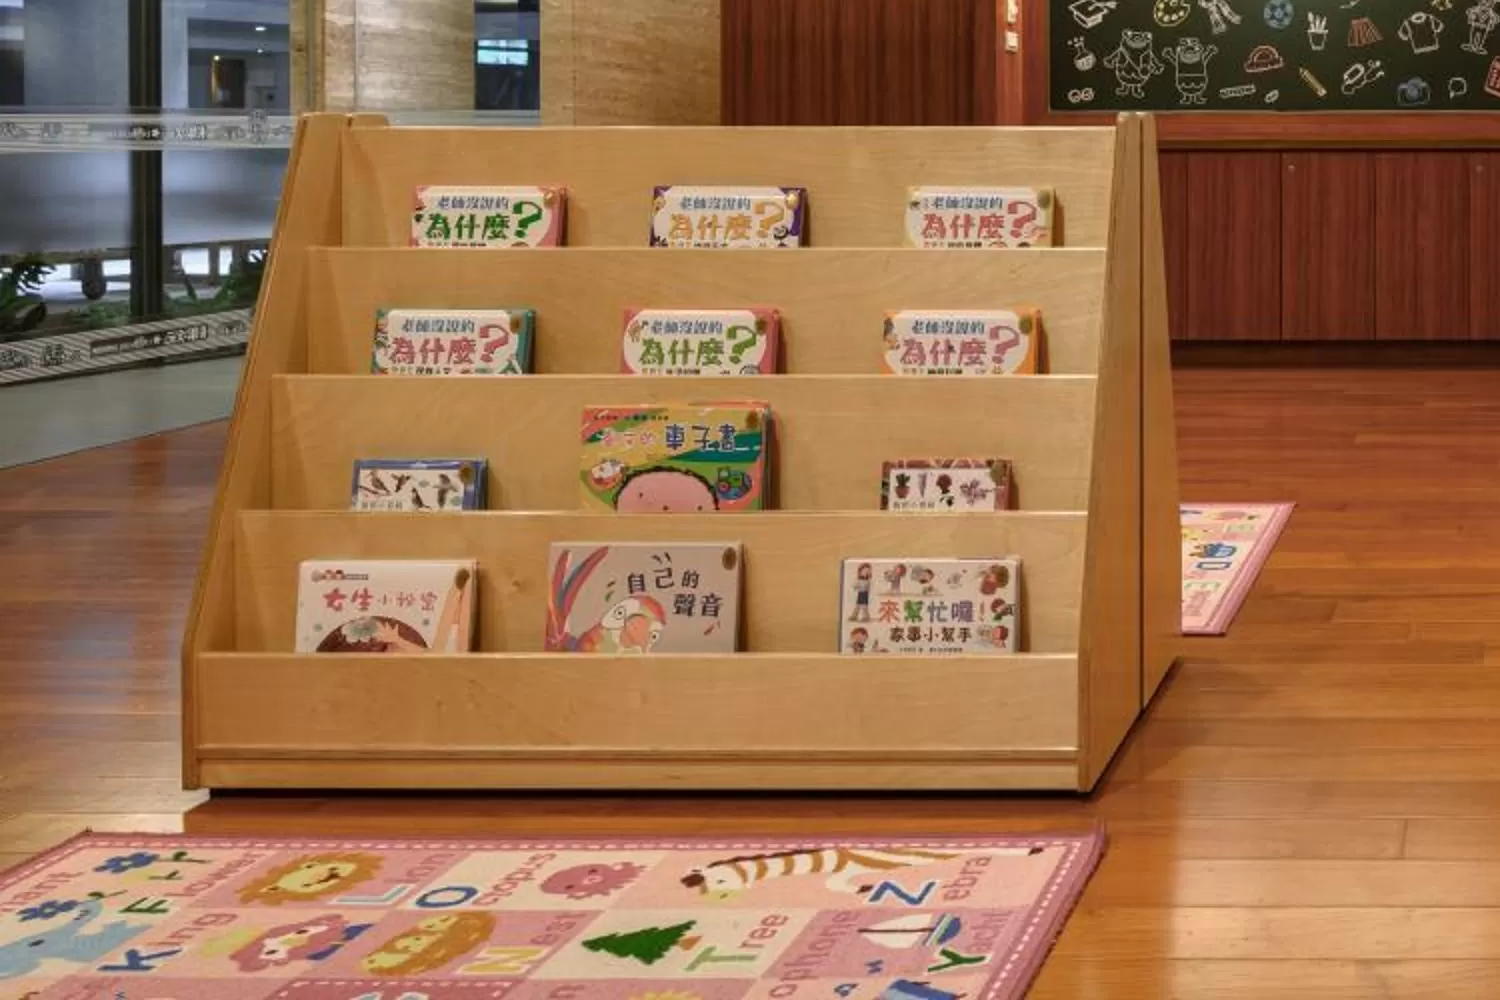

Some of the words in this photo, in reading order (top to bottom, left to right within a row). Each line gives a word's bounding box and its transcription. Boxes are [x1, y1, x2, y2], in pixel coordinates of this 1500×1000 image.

[627, 567, 700, 594] 自己的
[673, 593, 723, 617] 聲音
[869, 855, 992, 905] Zebra
[685, 914, 790, 973] Tree
